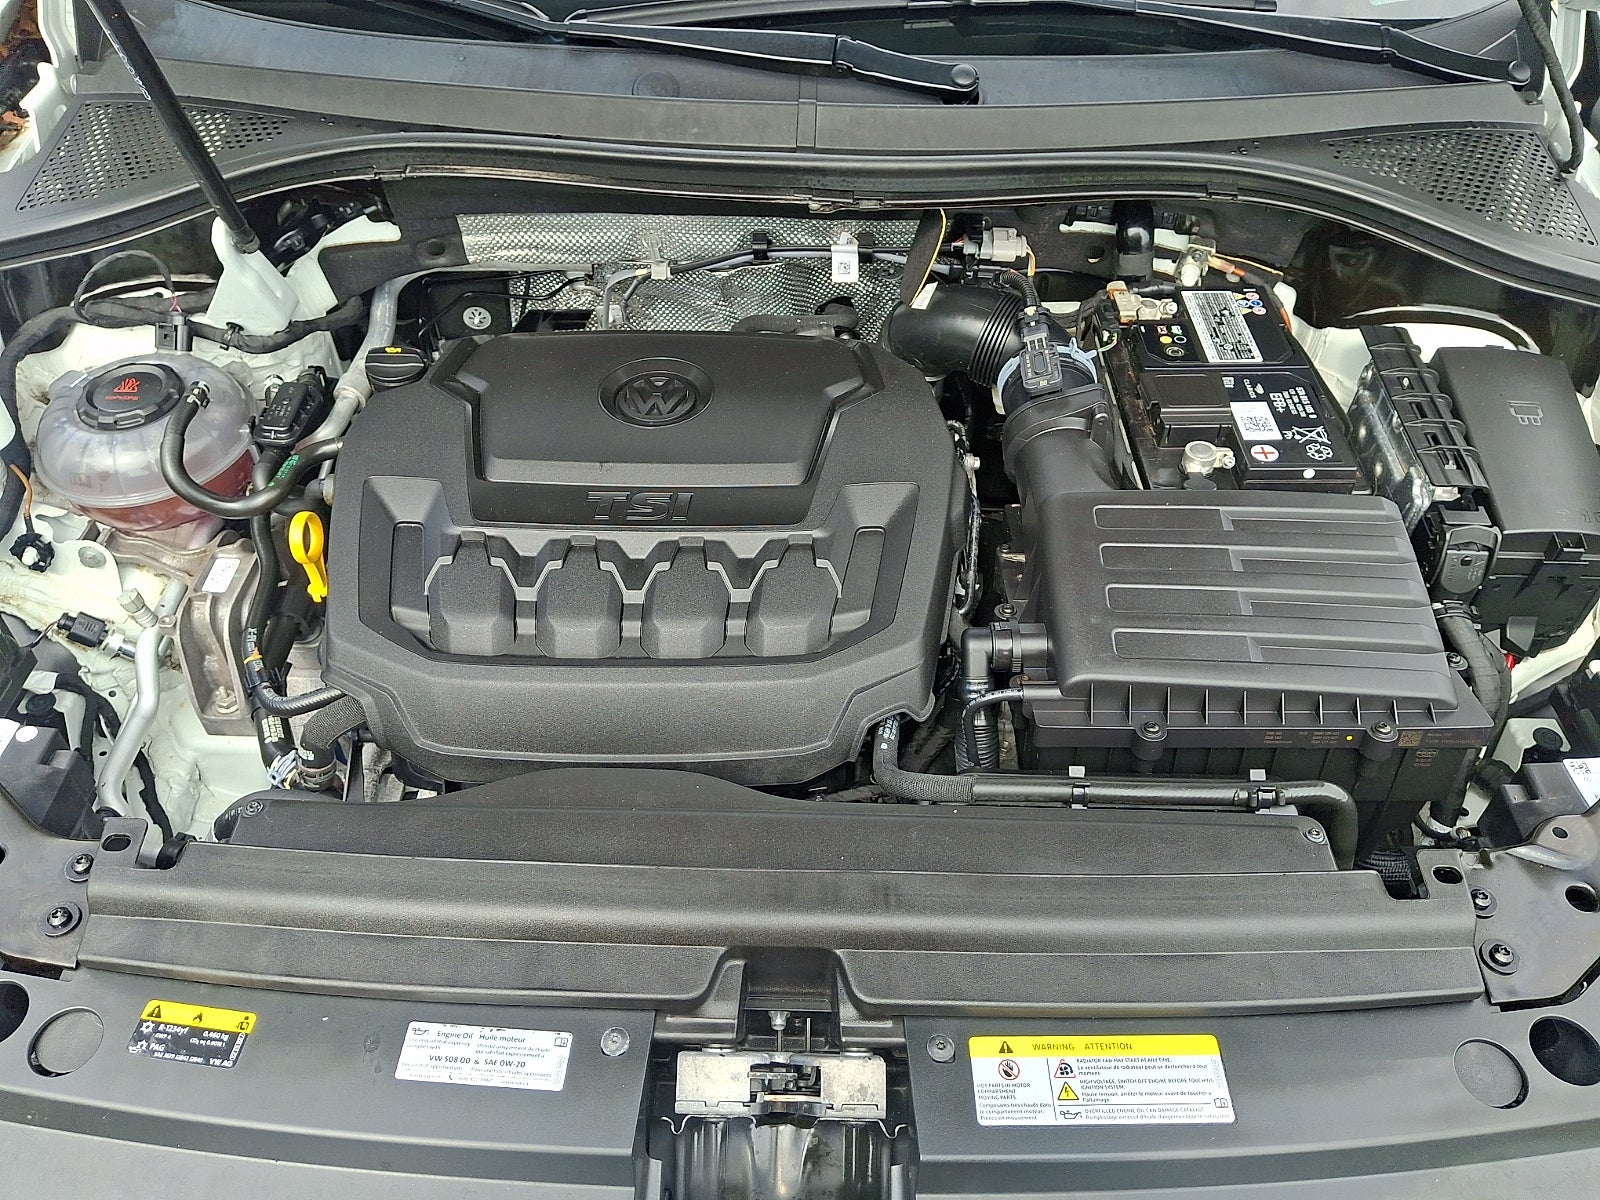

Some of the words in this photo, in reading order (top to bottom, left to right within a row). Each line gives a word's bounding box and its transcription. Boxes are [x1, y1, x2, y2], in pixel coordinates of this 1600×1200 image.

[1244, 379, 1256, 398] CLARIOS
[1269, 392, 1286, 413] EFB+
[1282, 430, 1293, 440] Pb
[587, 491, 695, 521] TSI
[158, 1024, 189, 1036] R-1234yf
[437, 1031, 461, 1039] Engine
[149, 1042, 165, 1051] PAG
[499, 1060, 526, 1068] 0W-20
